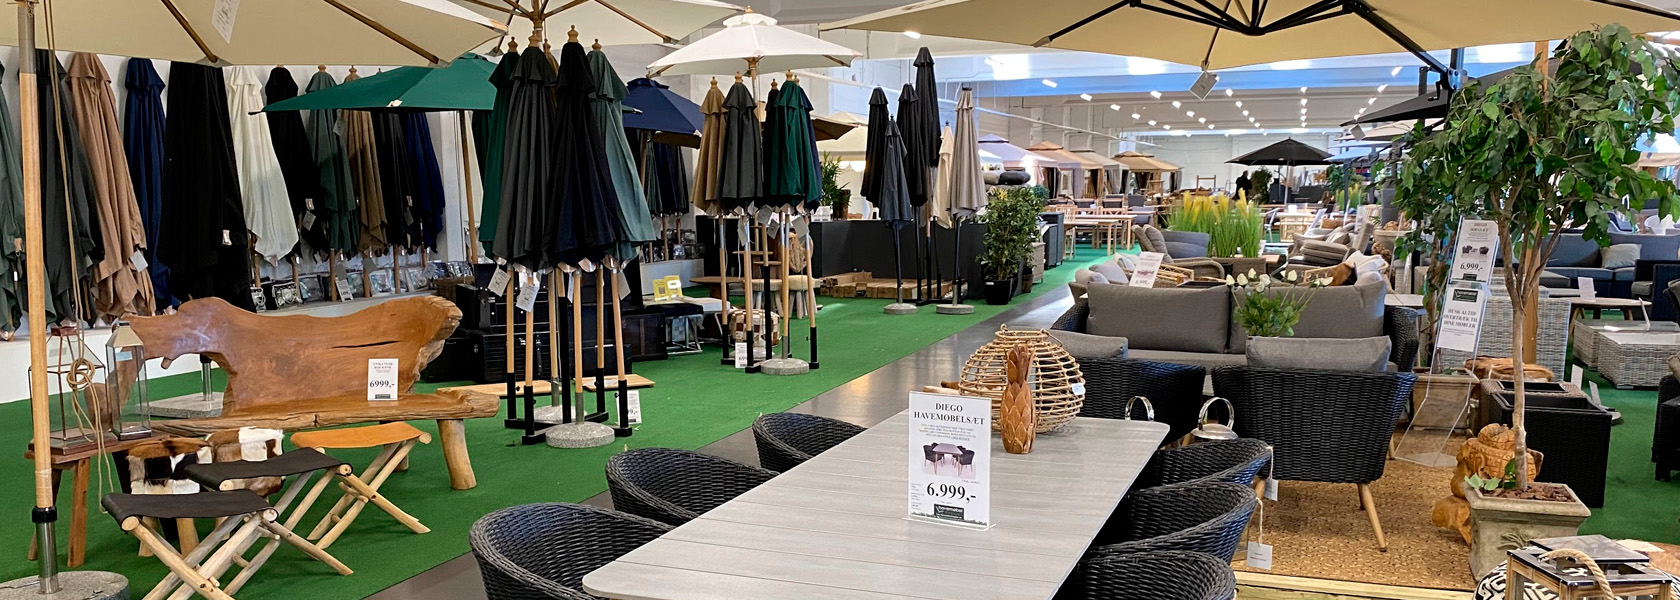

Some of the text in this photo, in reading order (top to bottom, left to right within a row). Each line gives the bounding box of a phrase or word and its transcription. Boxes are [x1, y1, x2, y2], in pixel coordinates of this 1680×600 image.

[1460, 262, 1483, 272] 6.999,-
[370, 380, 395, 388] 6999,-
[935, 402, 963, 412] DIEGO
[914, 411, 985, 425] HAVEMØBELSÆT
[926, 481, 976, 504] 6.999,-
